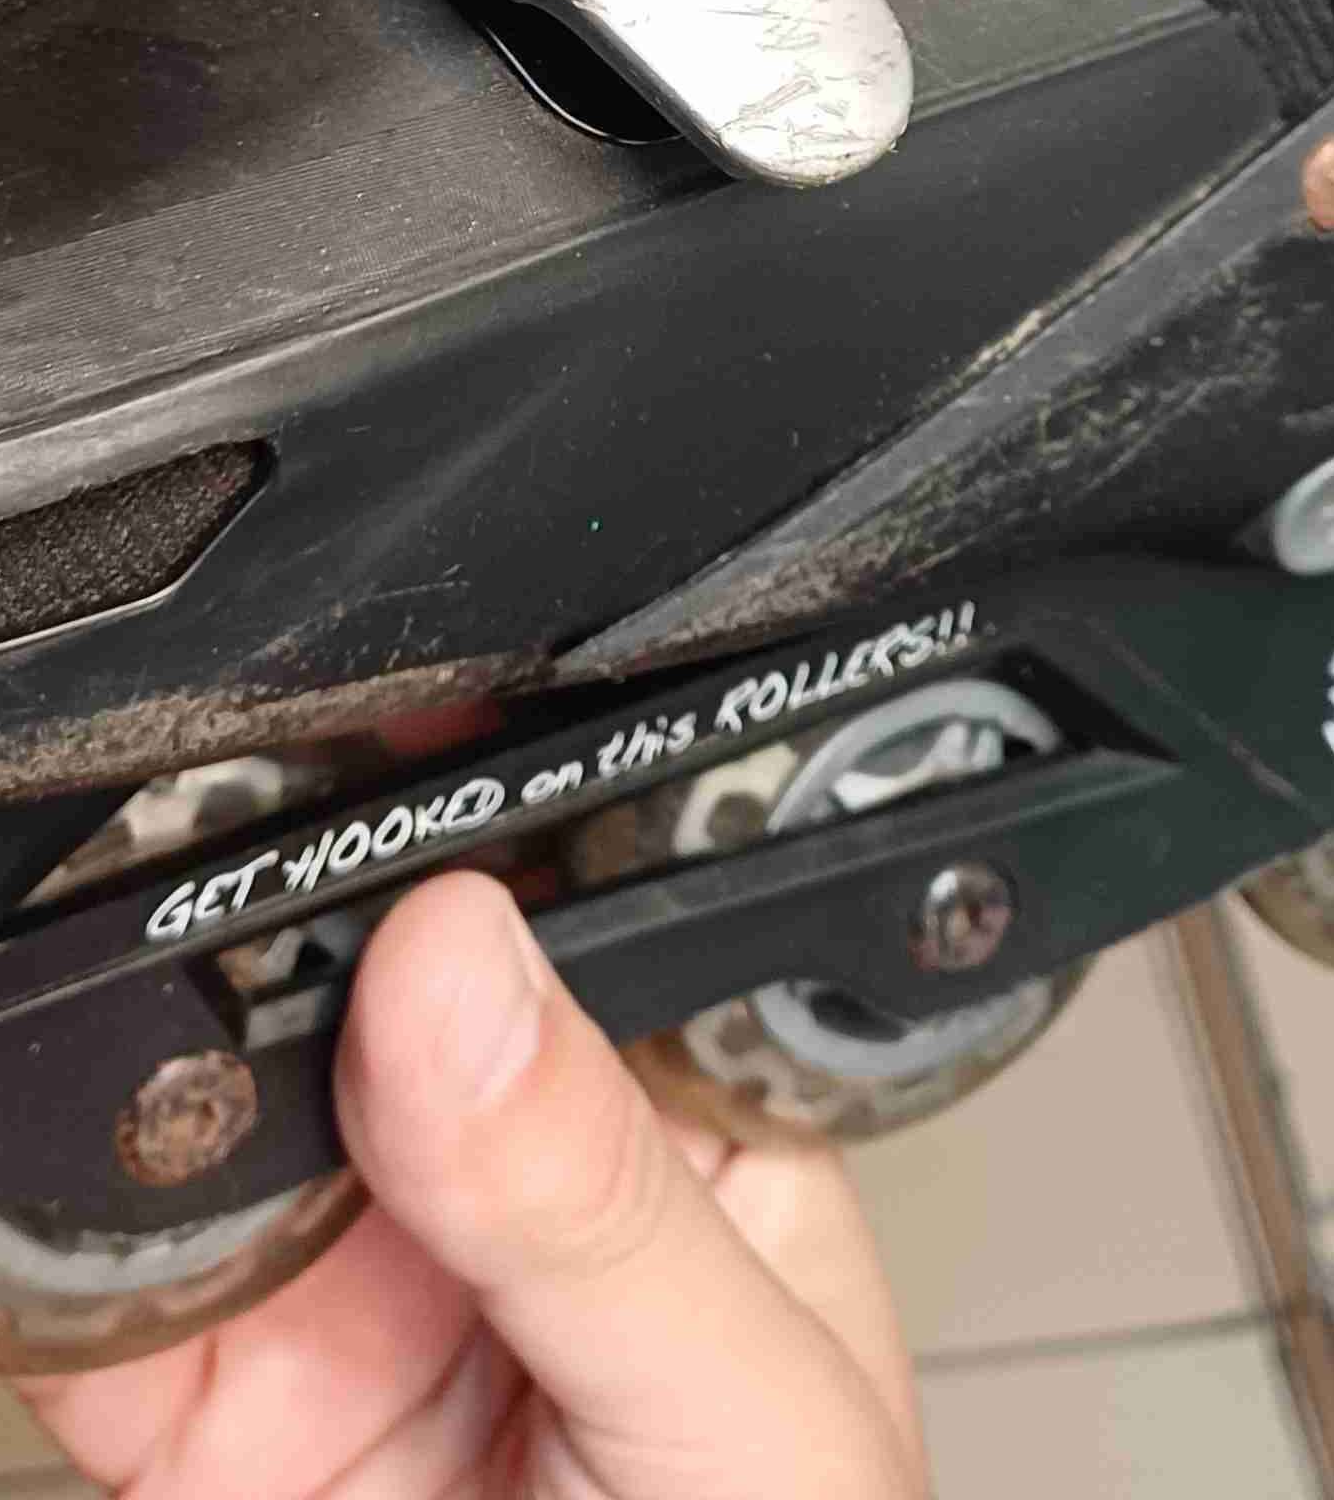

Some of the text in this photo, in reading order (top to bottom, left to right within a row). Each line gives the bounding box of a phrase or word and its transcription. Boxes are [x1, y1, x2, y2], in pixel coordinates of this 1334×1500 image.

[145, 600, 976, 941] GET HOOKED on this ROLLERS!!
